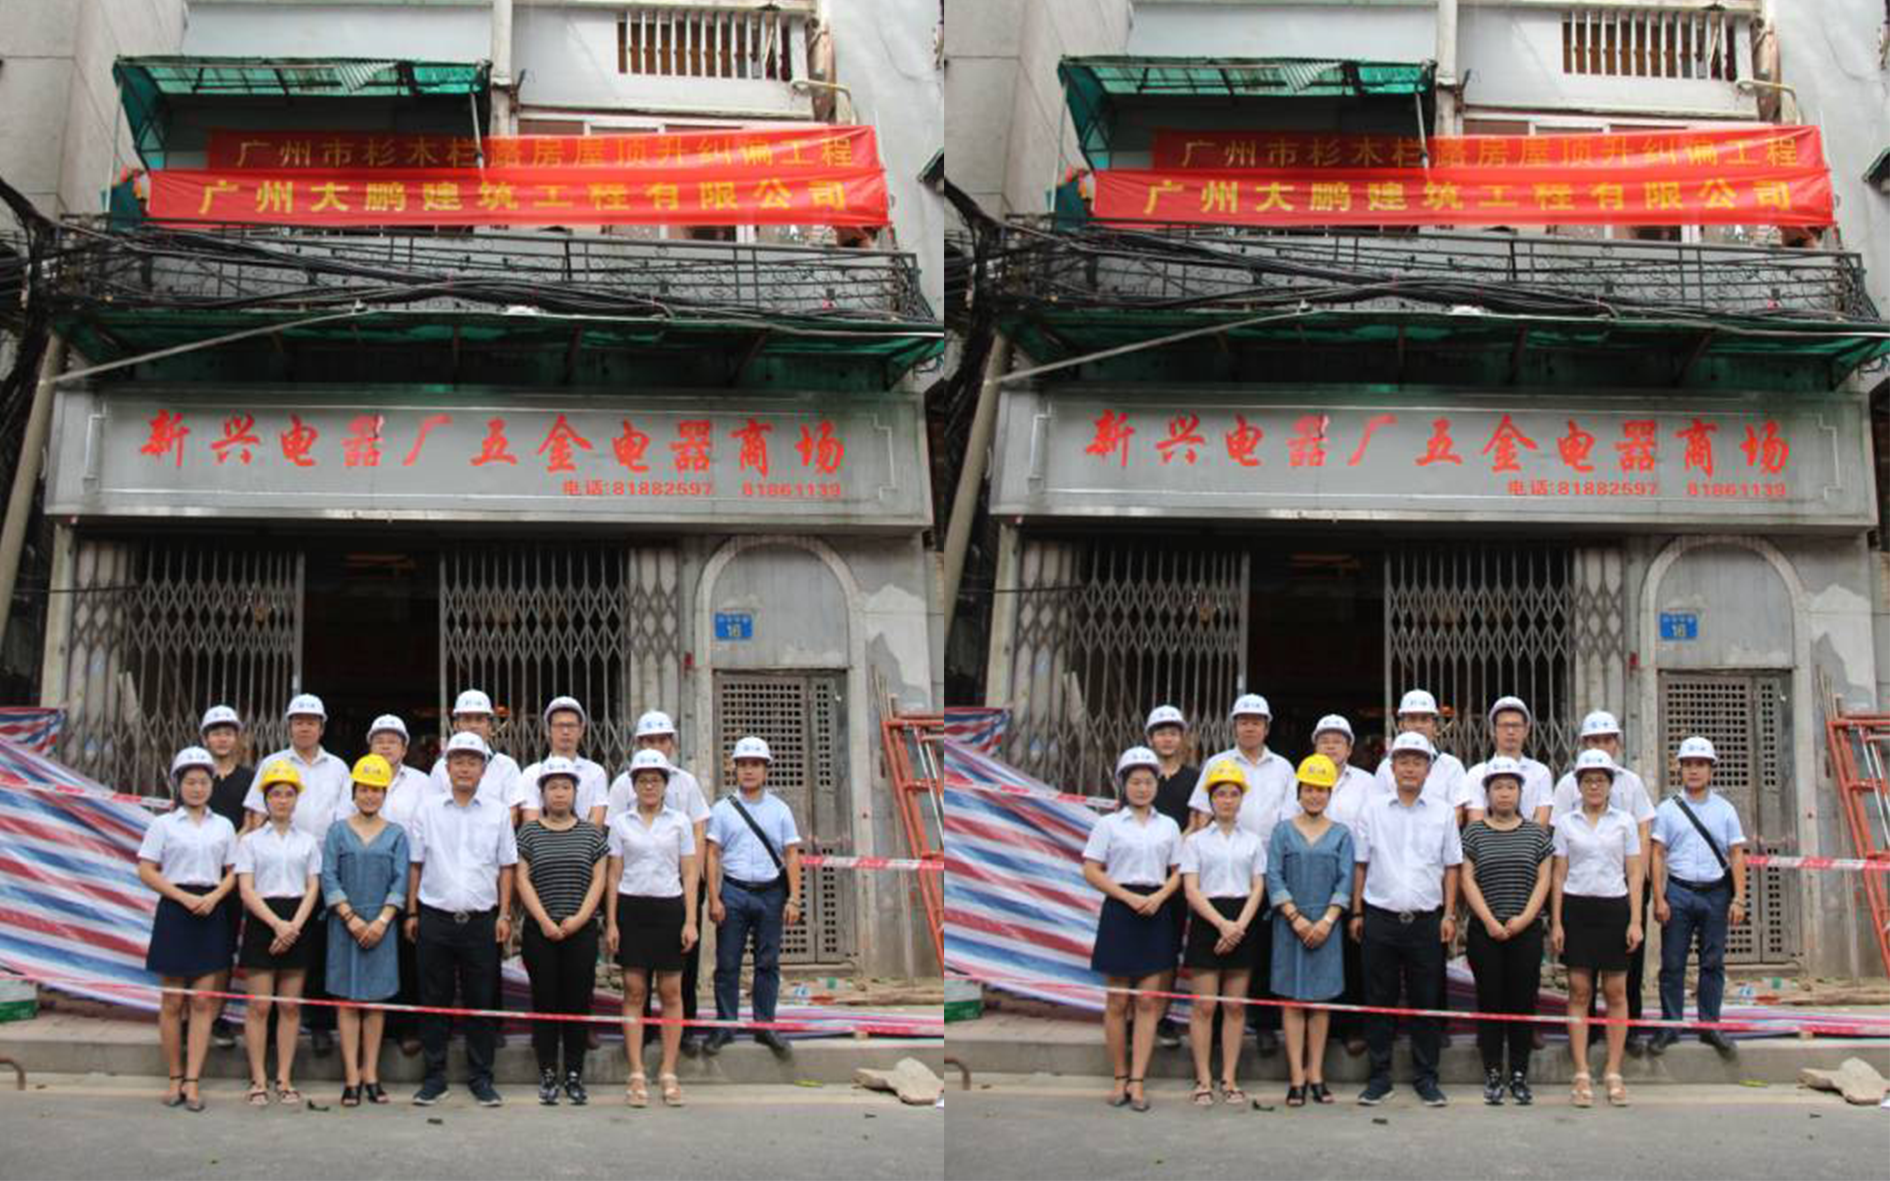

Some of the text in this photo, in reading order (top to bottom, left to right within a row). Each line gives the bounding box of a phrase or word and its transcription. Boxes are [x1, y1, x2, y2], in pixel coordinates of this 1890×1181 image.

[199, 178, 846, 214] 广州大鹏建筑工程有限公司
[1144, 178, 1791, 214] 广州大鹏建筑工程有限公司
[140, 409, 845, 477] 新兴电器厂五金电器商场
[1085, 409, 1790, 477] 新兴电器厂五金电器商场
